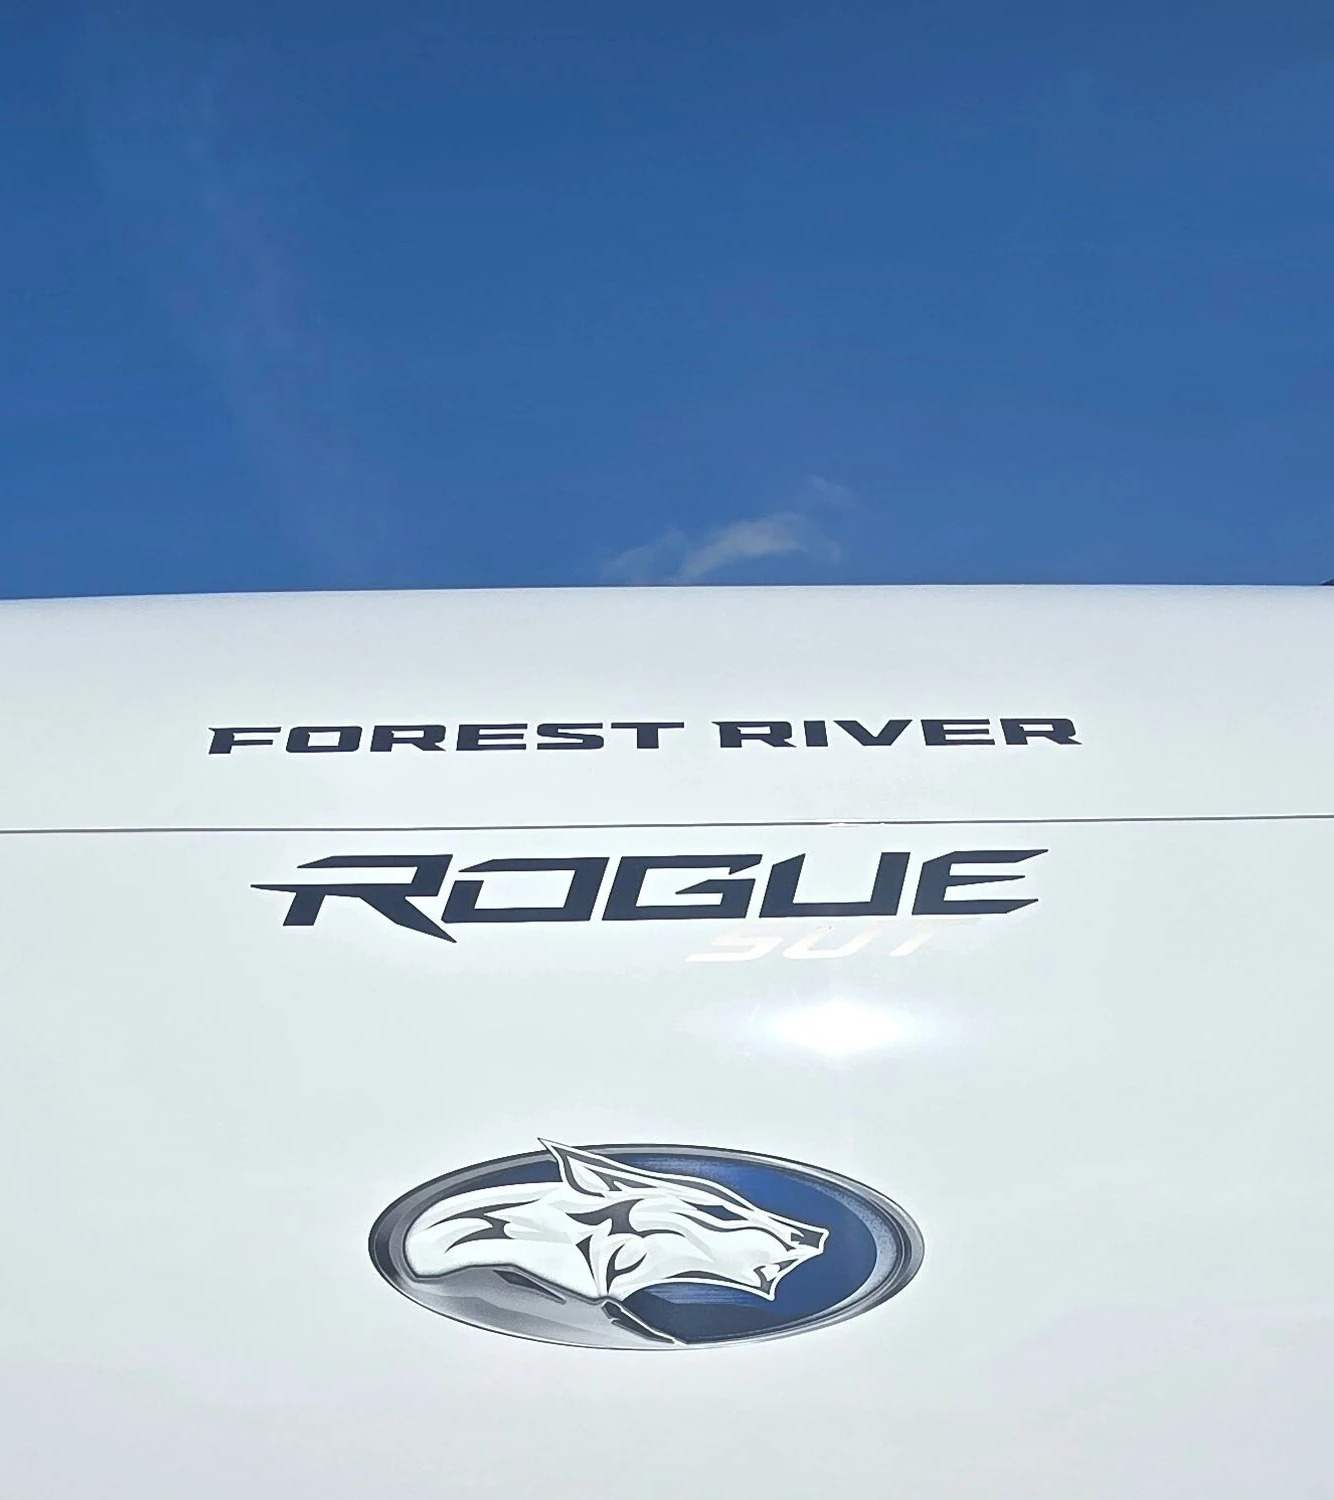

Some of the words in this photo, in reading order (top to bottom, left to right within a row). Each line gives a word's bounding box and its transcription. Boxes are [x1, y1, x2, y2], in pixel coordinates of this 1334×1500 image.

[208, 722, 685, 755] FOREST
[711, 718, 1082, 748] RIVER
[250, 849, 1049, 944] ROGUE
